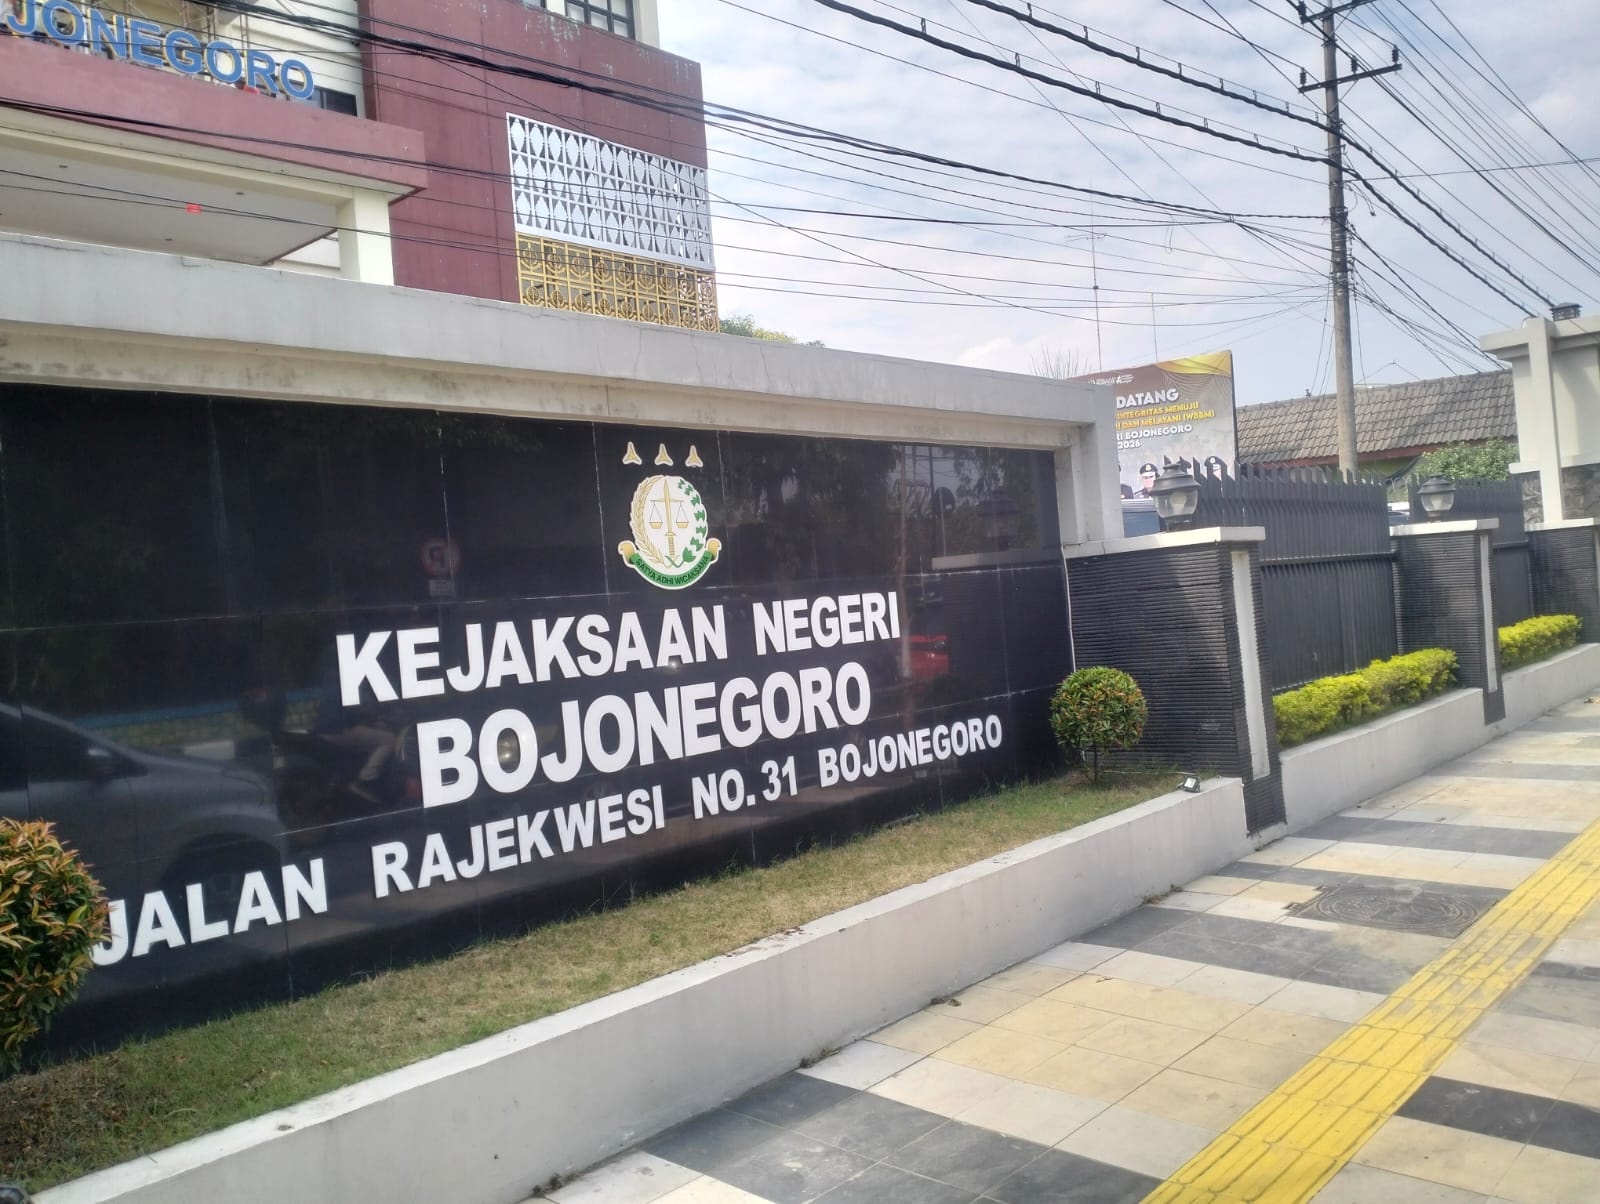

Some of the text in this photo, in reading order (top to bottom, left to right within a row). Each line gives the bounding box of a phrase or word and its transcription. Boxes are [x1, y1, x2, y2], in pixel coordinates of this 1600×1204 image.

[6, 0, 315, 100] JONEGORO
[1116, 388, 1179, 409] DATANG
[1165, 402, 1199, 414] MENUJU
[1121, 420, 1140, 429] DAN
[1141, 413, 1182, 426] MELAYANI
[1125, 424, 1193, 440] BOJONEGORO
[1117, 440, 1141, 450] 2026
[636, 556, 710, 585] SATYA ADHI WICAKSANA
[336, 591, 900, 707] KEJAKSAAN NEGERI
[416, 661, 871, 808] BOJONEGORO
[88, 857, 328, 966] JALAN
[371, 785, 665, 899] RAJEKWESI
[818, 714, 1003, 788] BOJONEGORO
